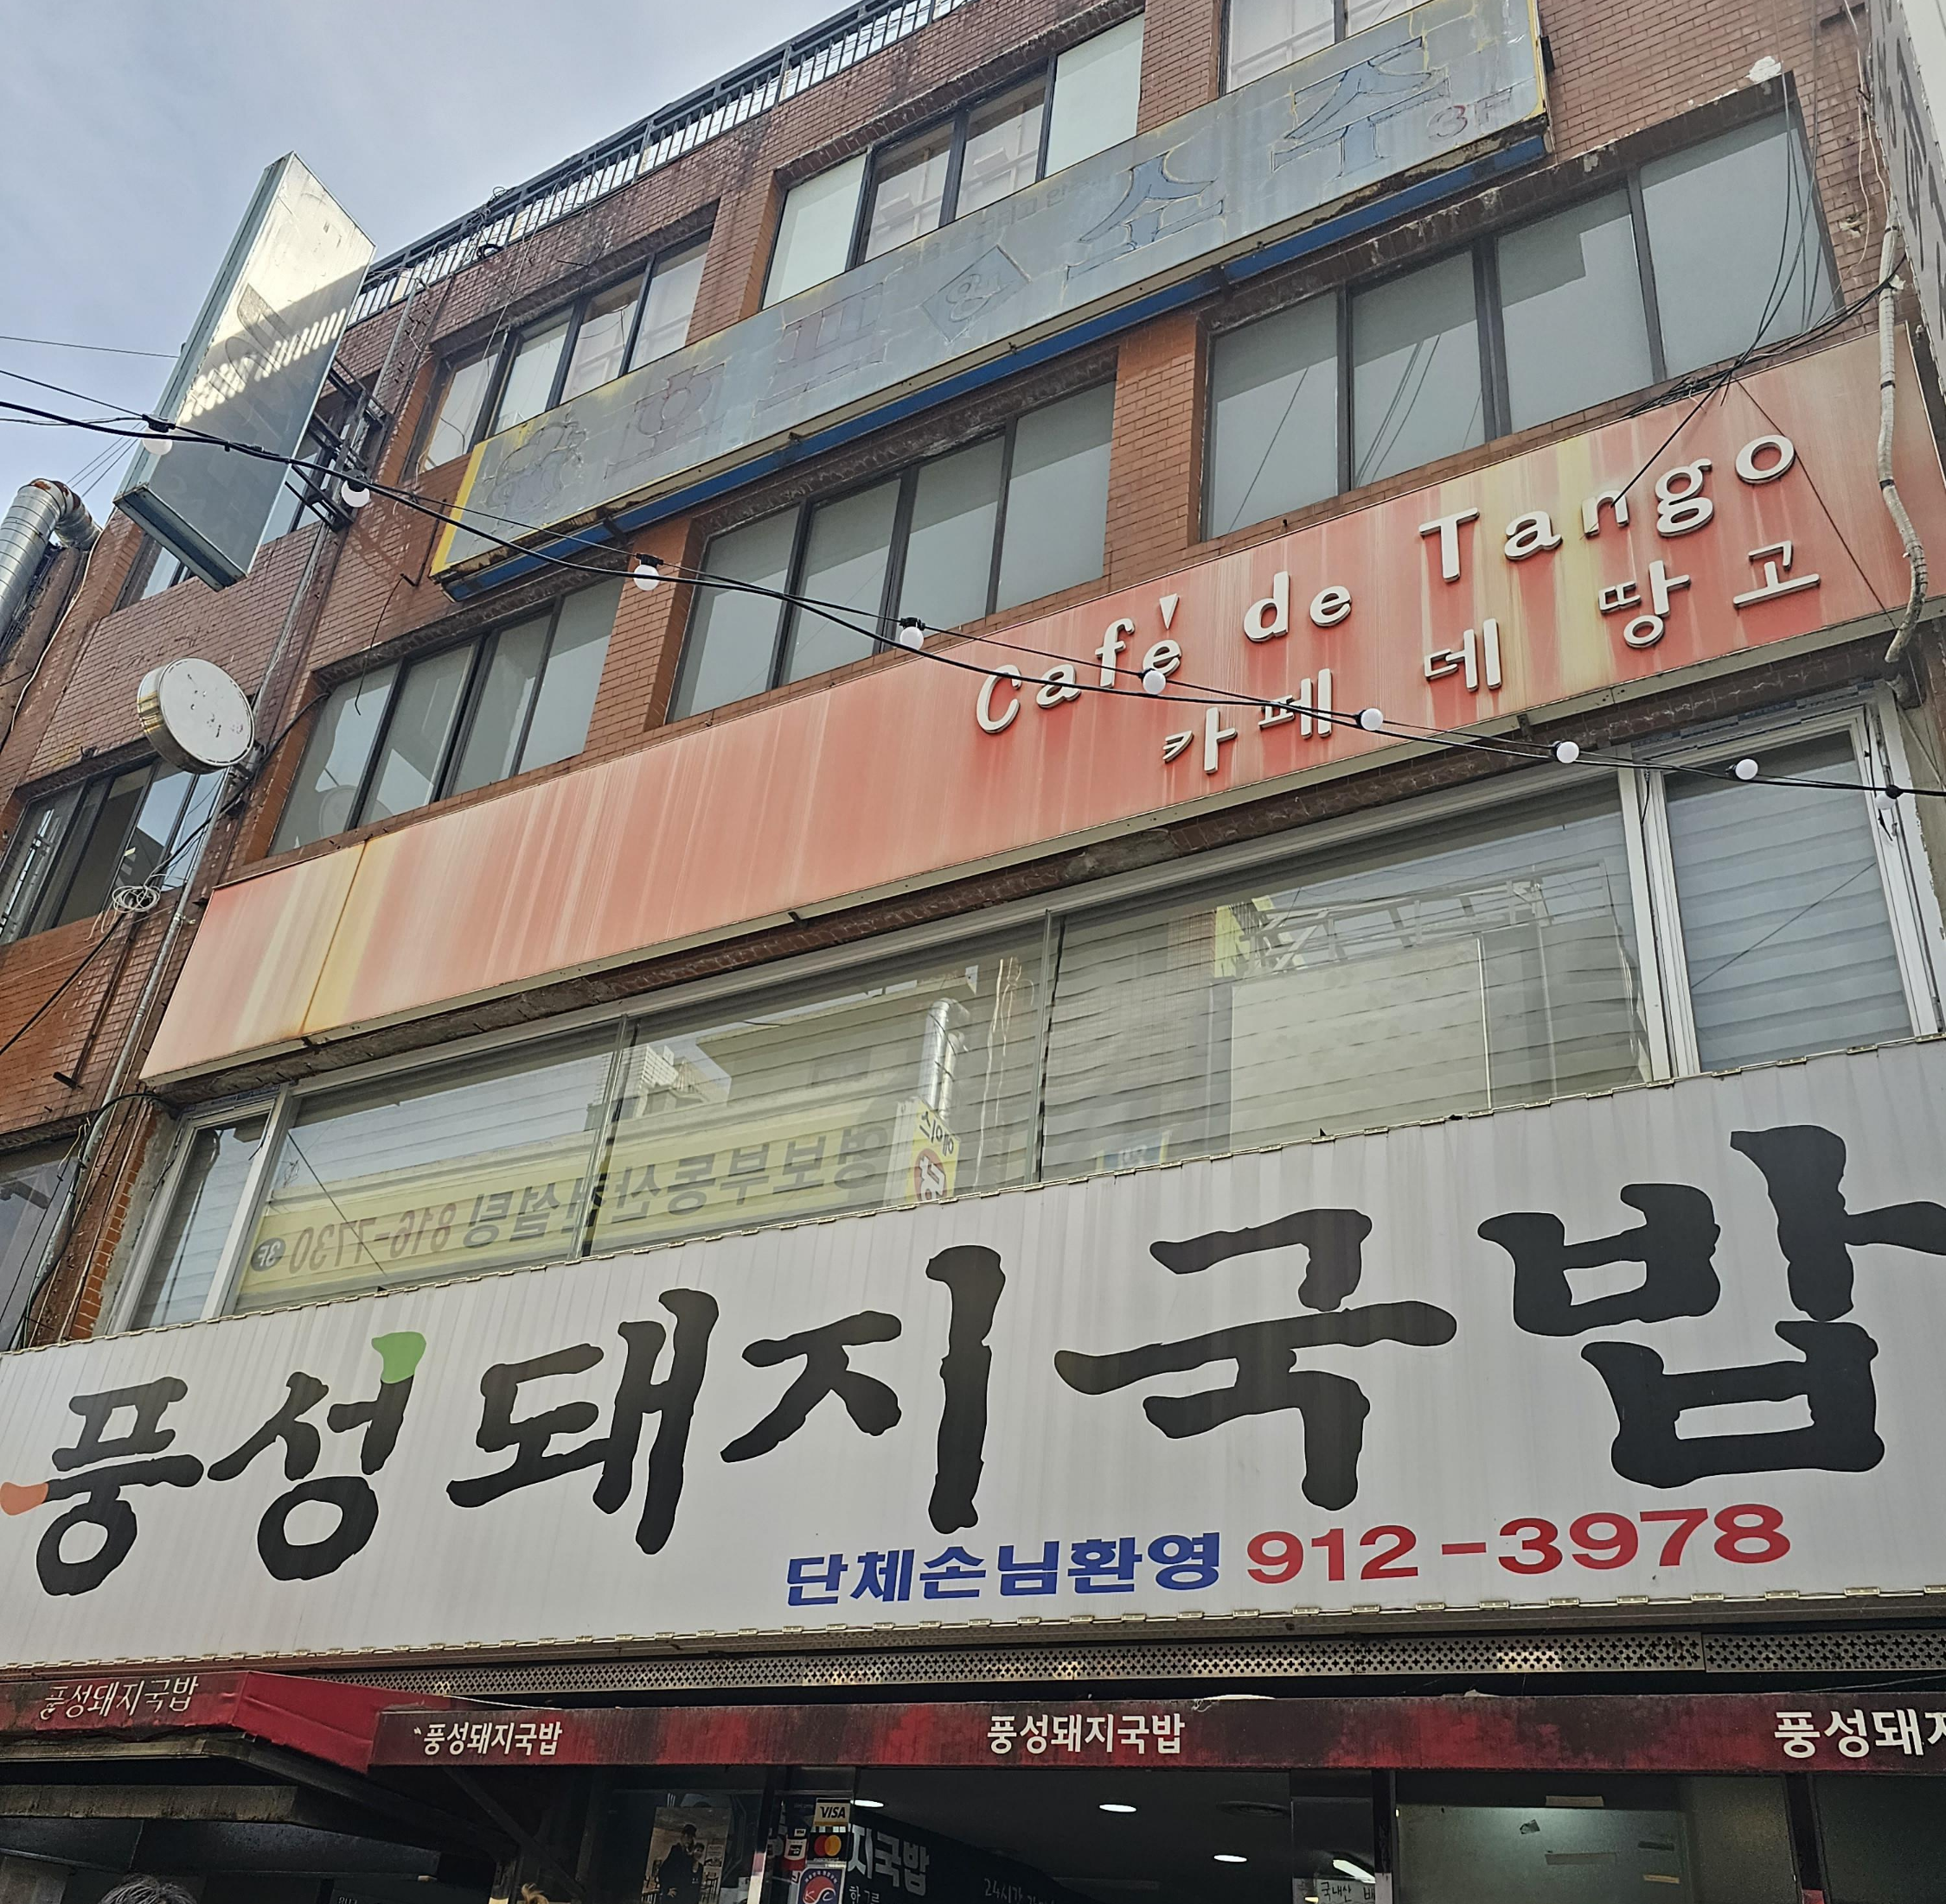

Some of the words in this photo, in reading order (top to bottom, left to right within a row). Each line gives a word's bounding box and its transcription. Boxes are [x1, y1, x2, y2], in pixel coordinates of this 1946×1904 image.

[1243, 571, 1353, 643] de
[1419, 433, 1797, 583] Tango
[1162, 668, 1333, 774] 카페
[1424, 617, 1503, 692] 데
[1598, 540, 1821, 649] 땅고
[40, 1676, 199, 1721] 풍성돼지국밥
[987, 1713, 1186, 1755] 풍성돼지국밥
[820, 1806, 846, 1819] VISA
